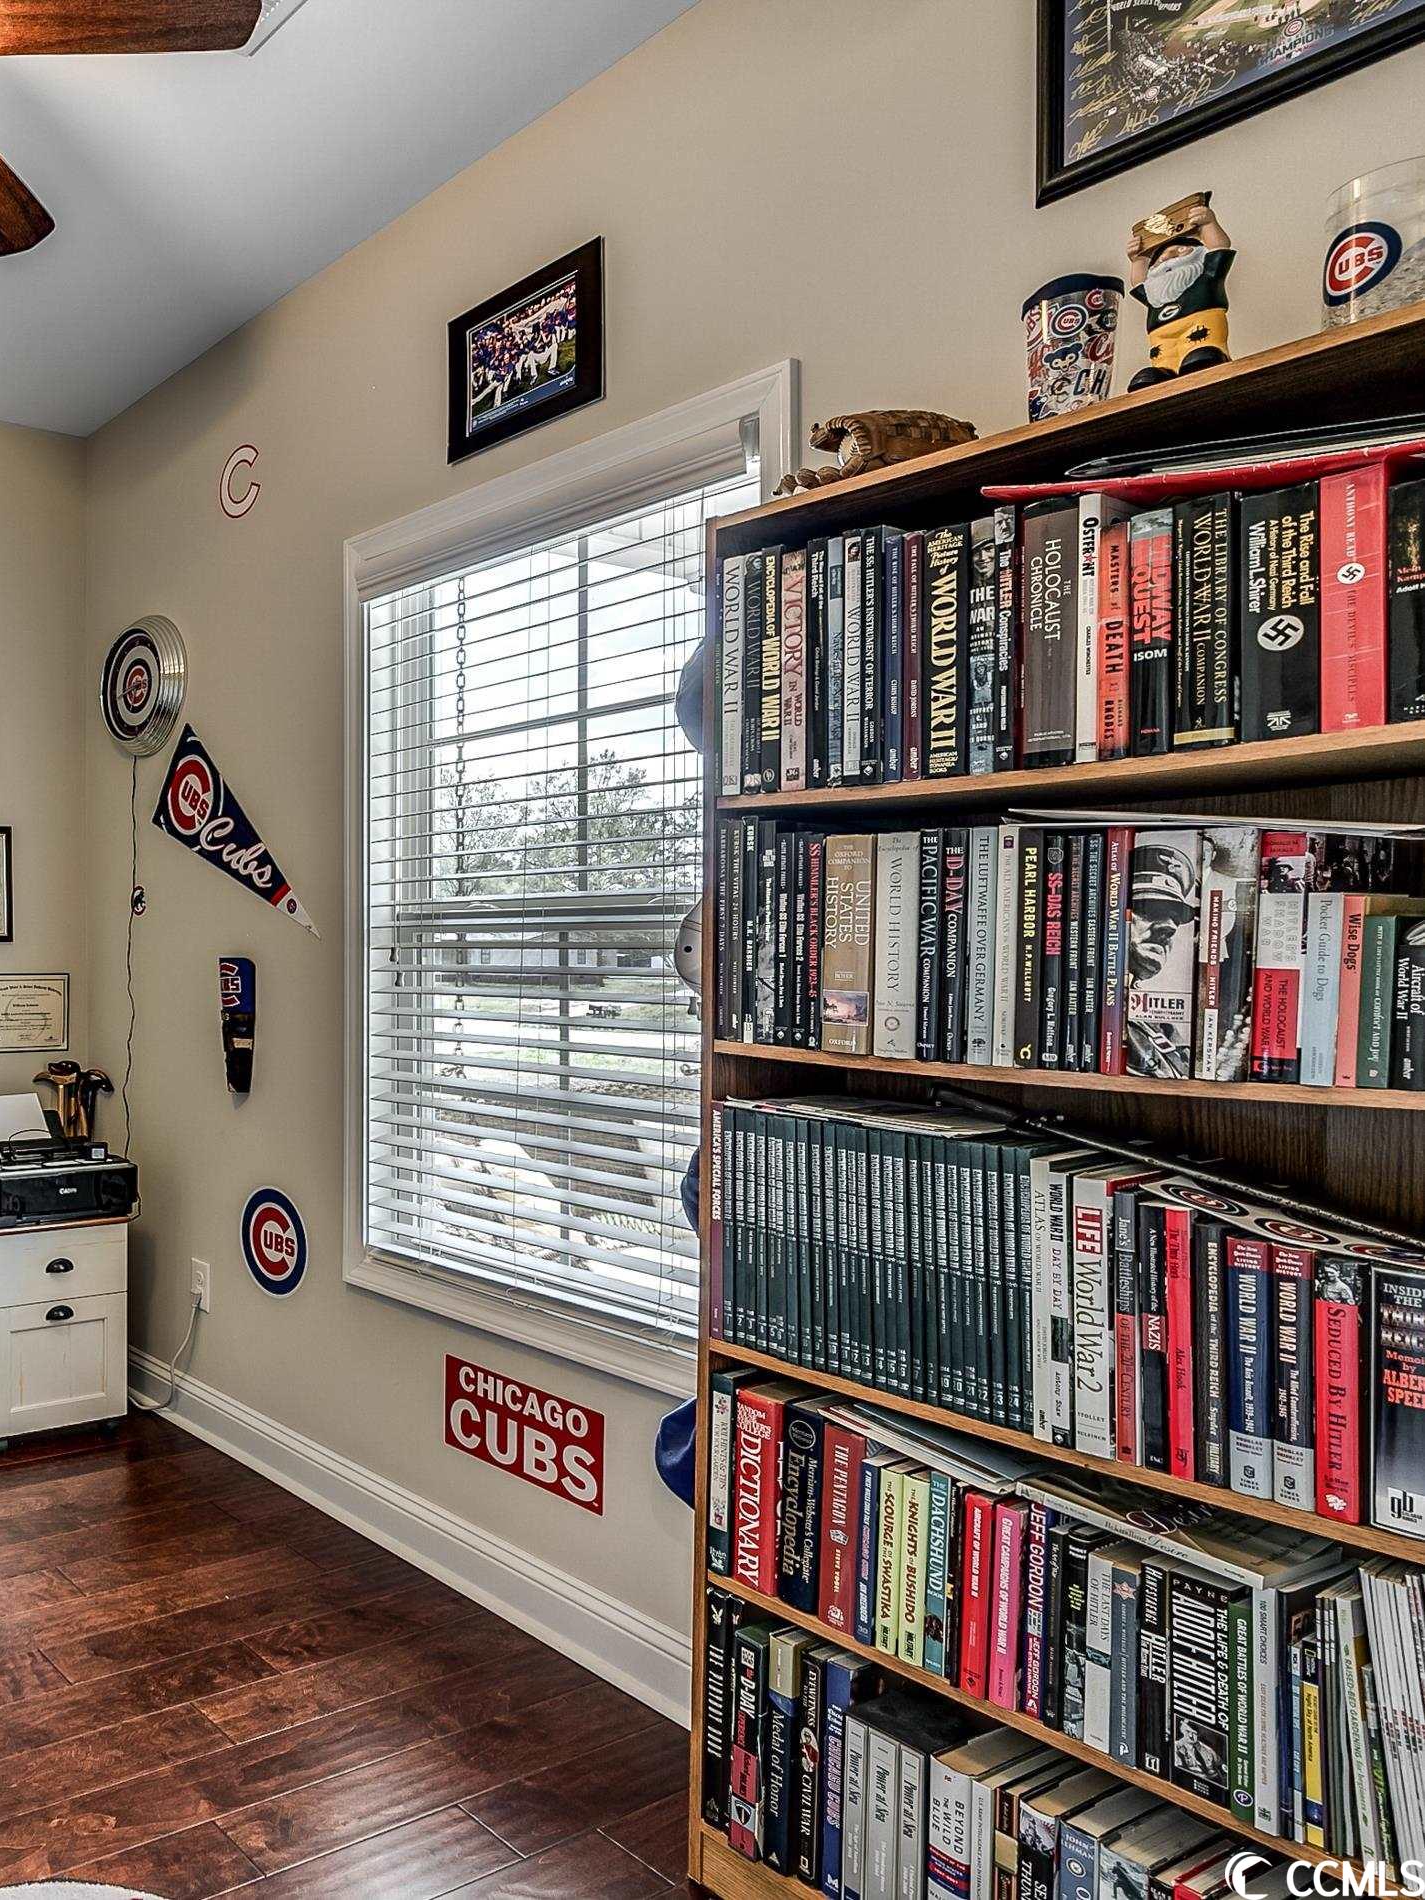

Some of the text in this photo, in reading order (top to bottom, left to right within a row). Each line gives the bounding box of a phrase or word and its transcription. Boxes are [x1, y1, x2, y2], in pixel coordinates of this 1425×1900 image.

[219, 444, 261, 518] C
[999, 549, 1010, 566] The
[1249, 520, 1266, 569] William
[1282, 516, 1297, 608] of the Third Reich
[1300, 510, 1315, 605] The Rise and Fall
[1029, 556, 1043, 632] CHRONICLE
[1044, 538, 1062, 641] HOLOCAUST
[1064, 579, 1073, 595] THE
[1150, 535, 1173, 641] MIDWAY
[1193, 512, 1212, 706] WORLD WAR II COMPANION
[1213, 509, 1228, 704] THE LIBRARY OF CONGRESS
[1249, 578, 1267, 613] Shirer
[761, 555, 780, 741] ENCYCLOPEDIA OF WORLD WAR II
[783, 577, 806, 677] VICTORY
[931, 571, 957, 749] WORLD WAR II
[996, 611, 1012, 671] Conspiracies
[1104, 619, 1124, 675] DEATH
[1133, 649, 1168, 661] ISOM
[200, 817, 272, 888] Cubs
[923, 836, 938, 844] THE
[825, 876, 839, 949] HISTORY
[838, 882, 855, 943] STATES
[854, 880, 871, 946] UNITED
[919, 845, 938, 1003] PACIFIC WAR COMPANION
[1022, 847, 1038, 938] PEARL HARBOR
[1343, 914, 1363, 971] Wise Dogs
[1131, 994, 1185, 1012] HITLER
[1208, 976, 1217, 1006] HITLER
[1275, 980, 1289, 1050] THE HOLOCAUST
[712, 1109, 722, 1221] AMERICA'S SPECIAL FORCES
[1076, 1205, 1103, 1255] LIFE
[1076, 1260, 1105, 1394] World War 2
[1237, 1274, 1257, 1357] WORLD WAR II
[1383, 1283, 1425, 1298] INSID
[1394, 1295, 1422, 1307] THE
[1147, 1314, 1161, 1351] NAZIS
[458, 1366, 589, 1439] CHICAGO
[1326, 1306, 1347, 1471] SEDUCED BY HITLER
[1387, 1388, 1425, 1408] SPEE
[448, 1399, 598, 1503] CUBS
[832, 1444, 850, 1530] THE PENTAGON
[737, 1430, 761, 1589] DICTIONARY
[782, 1449, 806, 1577] Encyclopedia
[884, 1492, 895, 1549] SCOURGE
[925, 1491, 947, 1592] DACHSHUND
[879, 1555, 892, 1619] SWASTIKA
[904, 1500, 919, 1624] KNIGHTS BUSHIDO
[1027, 1503, 1047, 1613] JEFF GORDON
[1173, 1592, 1217, 1724] ADOLF HITLER
[740, 1677, 756, 1718] D-DAY
[769, 1711, 784, 1818] Medal of Honor
[825, 1735, 843, 1830] CHICAGO CUBS
[800, 1775, 813, 1836] CIVIL WAR
[932, 1797, 941, 1833] BLUE
[942, 1809, 953, 1846] WILD
[953, 1800, 966, 1855] BEYOND
